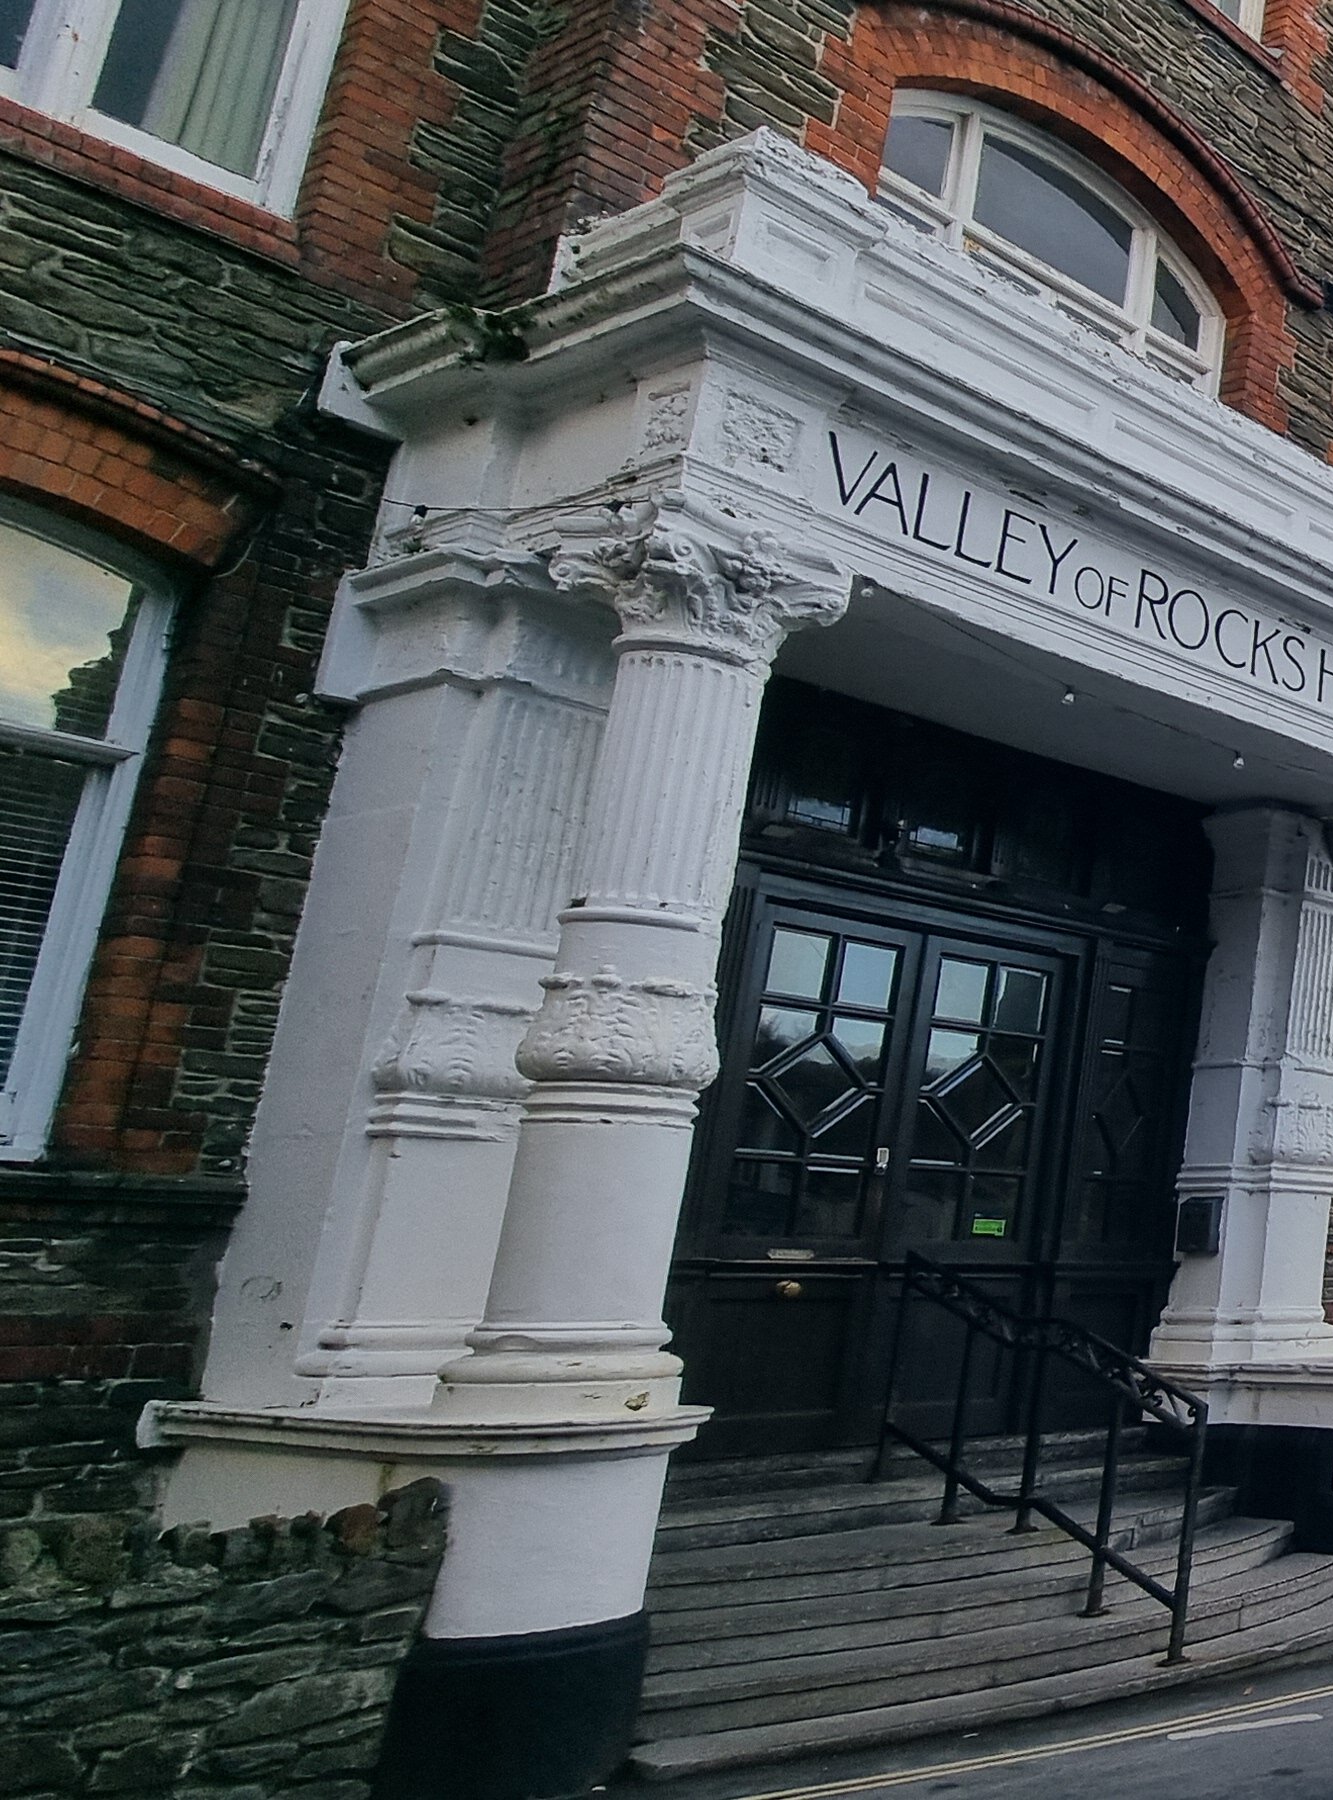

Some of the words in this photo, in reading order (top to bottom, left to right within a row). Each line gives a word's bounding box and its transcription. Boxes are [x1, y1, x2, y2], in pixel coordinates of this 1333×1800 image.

[828, 431, 1079, 595] VALLEY
[1074, 565, 1130, 618] OF
[1134, 568, 1305, 692] ROCKS
